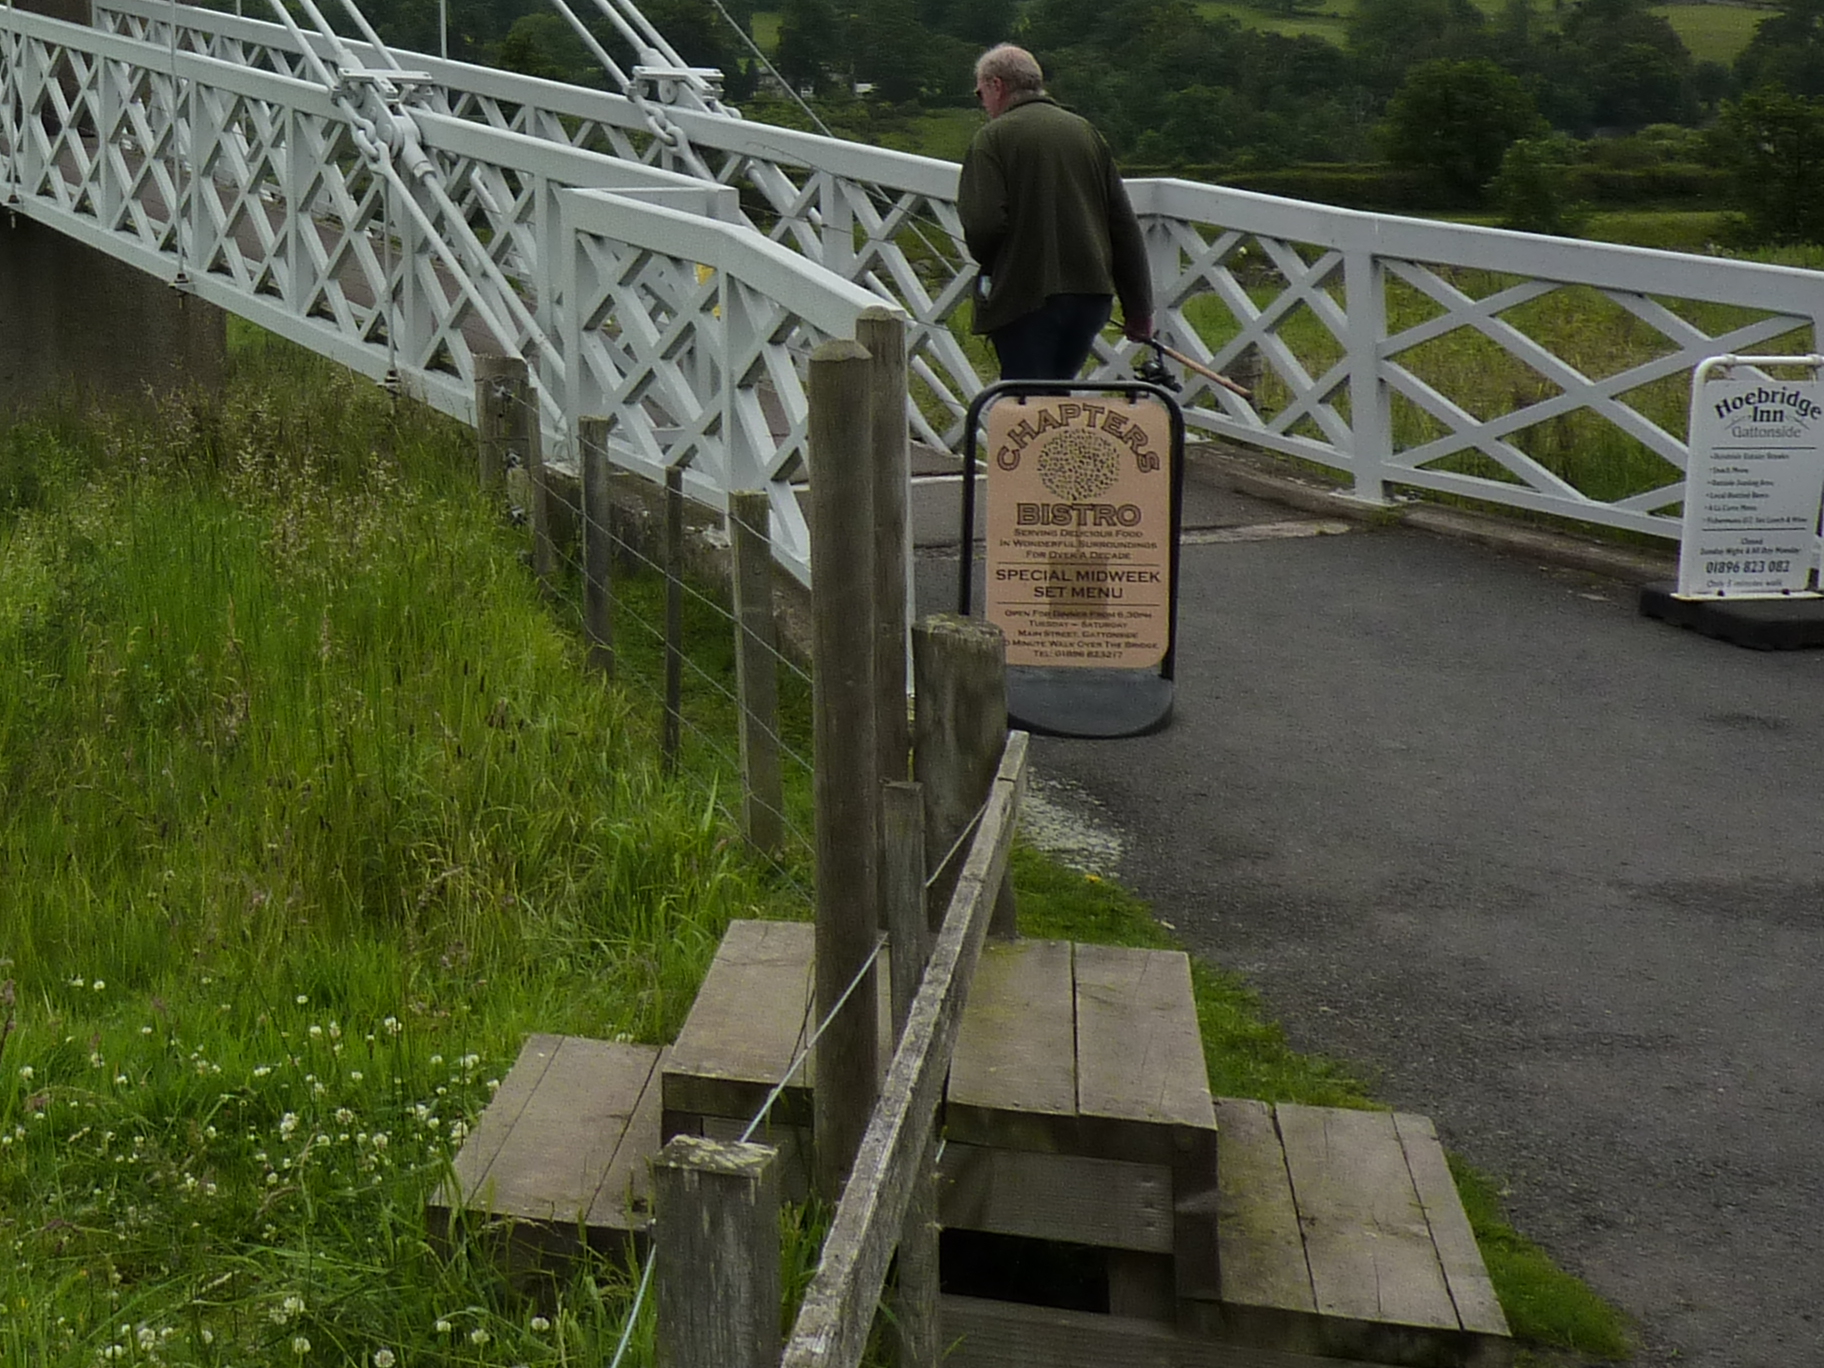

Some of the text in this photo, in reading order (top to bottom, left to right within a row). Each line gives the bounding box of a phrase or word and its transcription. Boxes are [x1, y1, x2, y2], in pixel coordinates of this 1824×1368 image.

[1714, 386, 1822, 420] Hoebridge
[1752, 406, 1785, 422] Inn
[997, 402, 1161, 474] CHAPTERS
[1732, 426, 1802, 438] Gattonside
[1016, 502, 1142, 527] BISTRO
[1706, 561, 1740, 574] 01896
[1743, 561, 1766, 573] 823
[995, 569, 1161, 583] SPECIAL MIDWEEK
[1033, 586, 1124, 599] SET MENU
